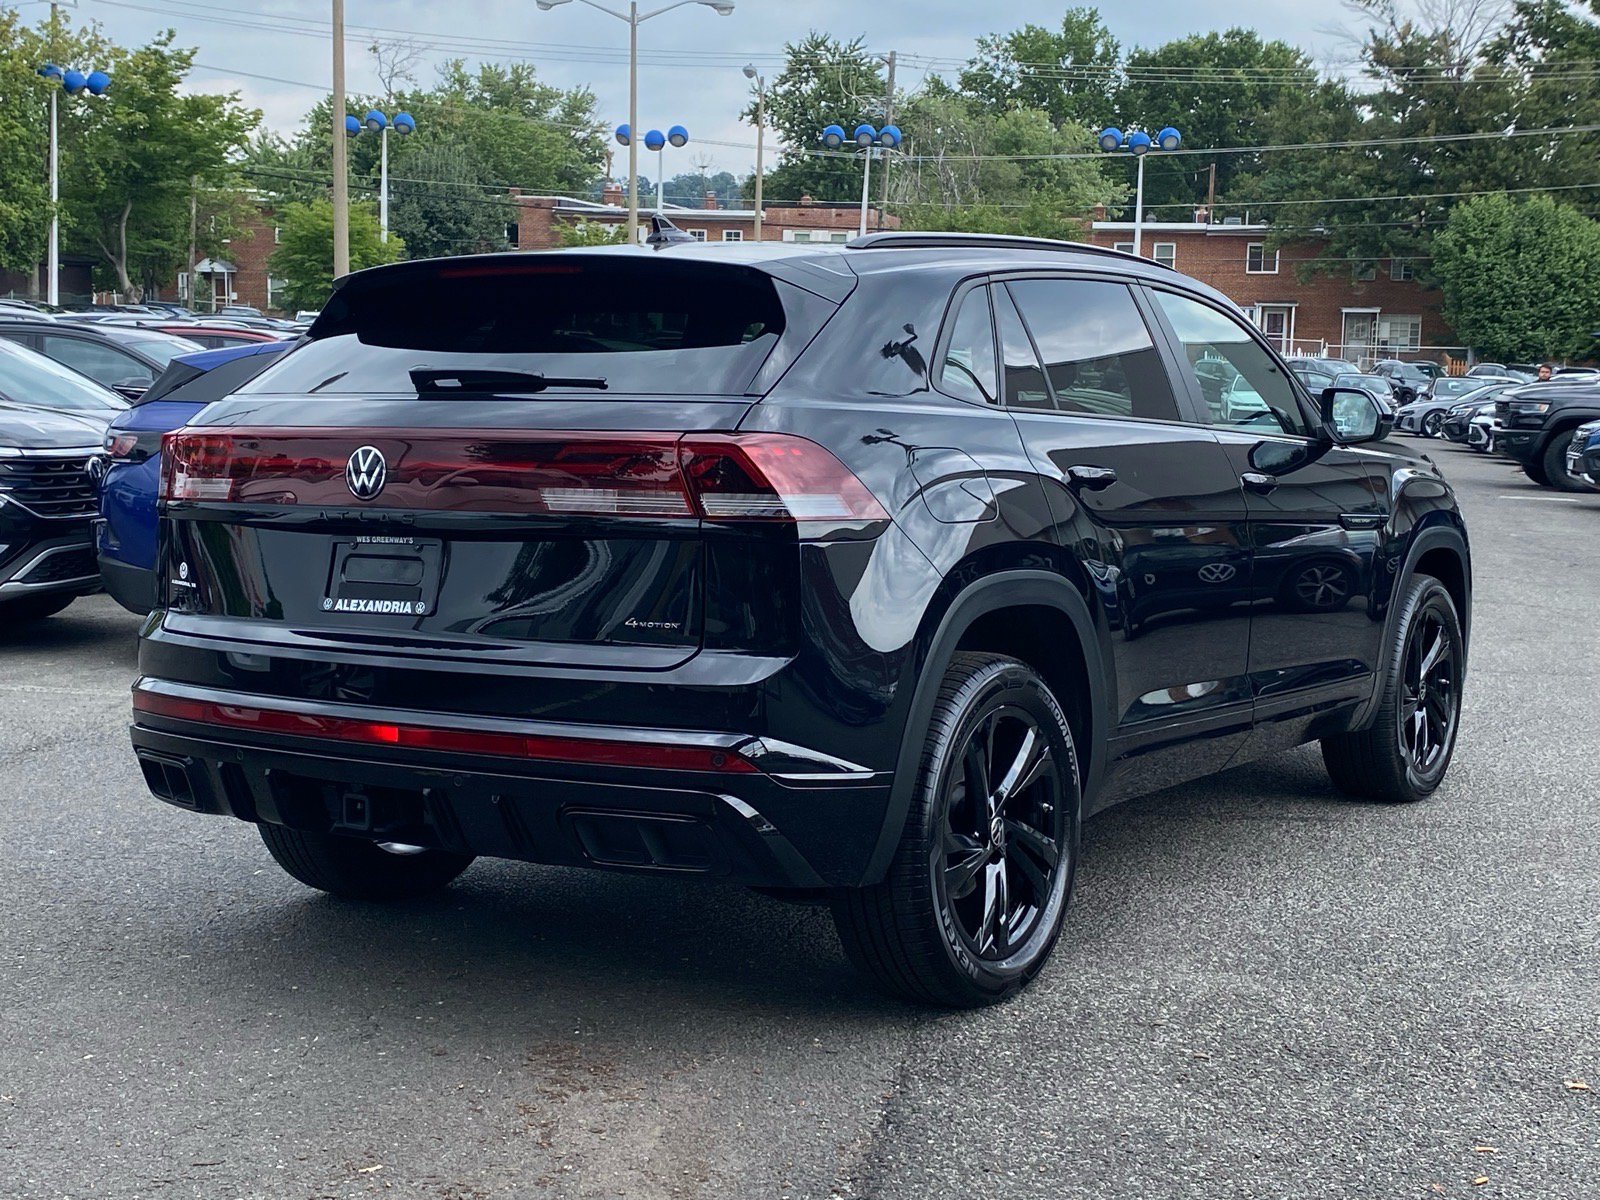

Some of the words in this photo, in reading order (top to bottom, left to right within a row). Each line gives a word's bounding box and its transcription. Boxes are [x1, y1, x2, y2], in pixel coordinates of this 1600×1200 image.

[319, 510, 416, 525] ATLAS
[356, 535, 371, 543] WES
[371, 536, 414, 545] GREENWAY'S
[334, 598, 412, 614] ALEXANDRIA
[624, 617, 681, 629] 4MOTION
[941, 906, 979, 981] NEXEN
